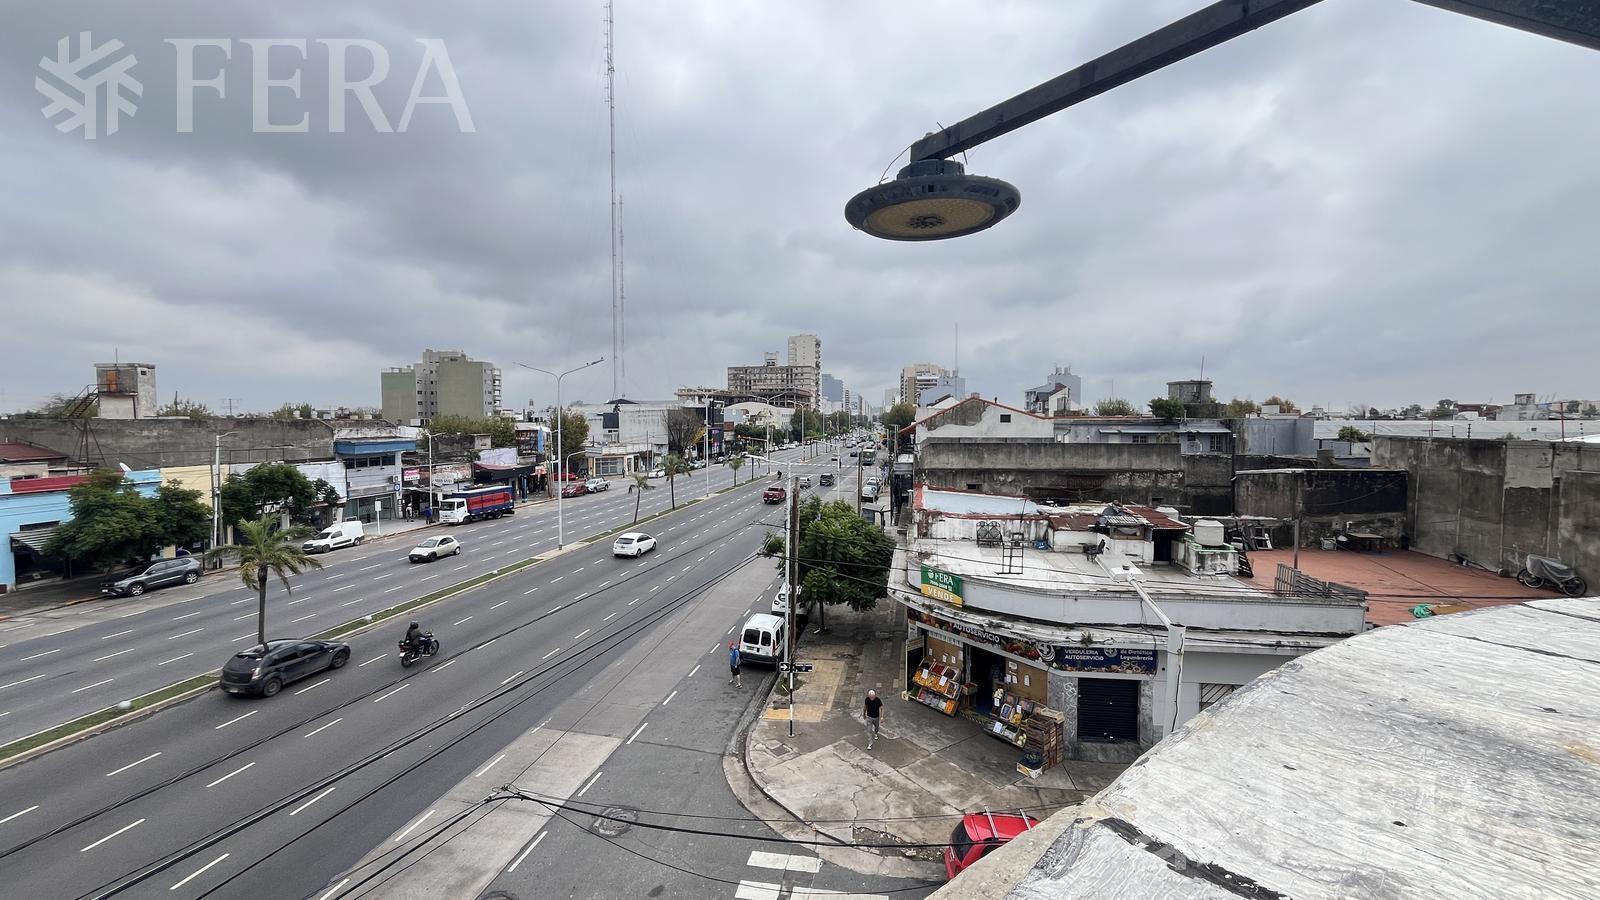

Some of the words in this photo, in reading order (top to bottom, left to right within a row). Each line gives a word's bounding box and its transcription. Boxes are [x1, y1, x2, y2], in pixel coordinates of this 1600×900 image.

[934, 572, 954, 586] FERA
[927, 586, 954, 603] VENDE
[953, 623, 1000, 643] AUTOSERVICIO
